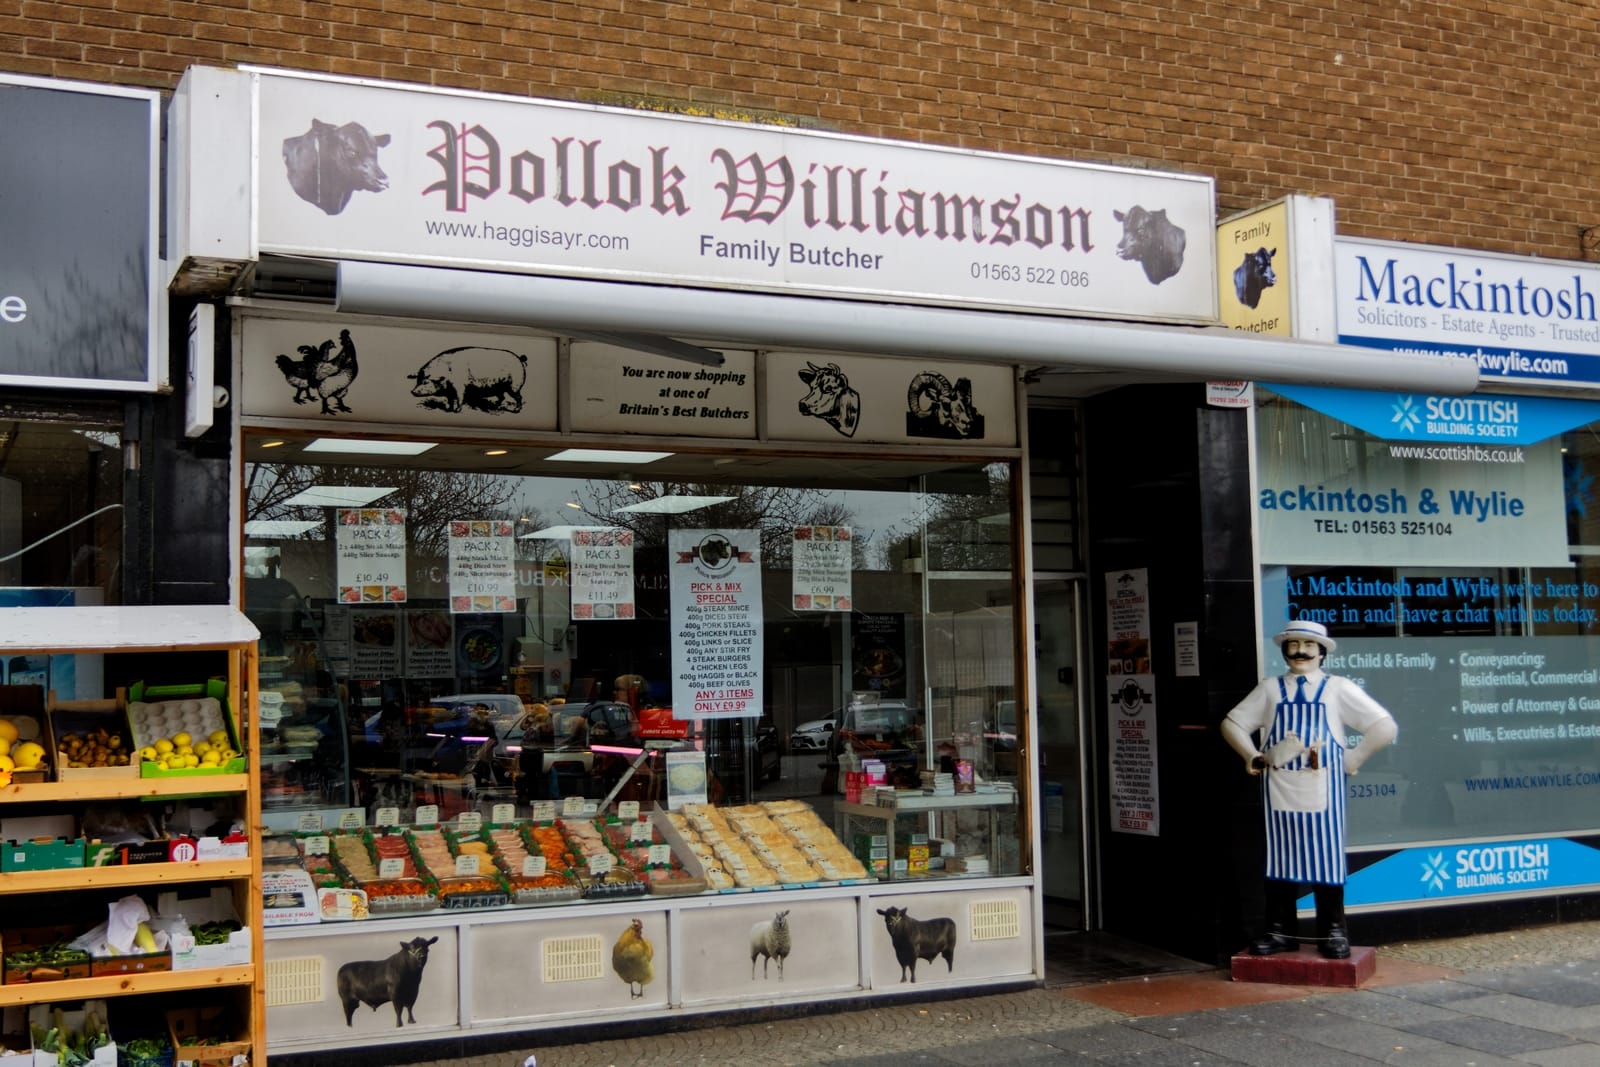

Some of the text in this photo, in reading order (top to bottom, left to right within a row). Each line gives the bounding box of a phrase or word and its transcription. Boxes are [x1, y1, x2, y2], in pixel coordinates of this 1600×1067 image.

[423, 119, 1095, 253] Pollok Williamson
[425, 219, 629, 251] www.haggisayr.com
[1235, 221, 1271, 244] Family
[700, 234, 883, 270] Family Butcher
[970, 261, 1089, 288] 01563 522 086
[1355, 256, 1598, 321] Mackintosh
[1357, 306, 1427, 329] Solicitors
[1441, 313, 1484, 334] Estate
[1488, 318, 1536, 341] Agents
[1548, 322, 1600, 343] Trusted
[1393, 348, 1568, 375] mackwylie.com
[622, 366, 746, 386] You are now shopping
[659, 387, 711, 399] at one of
[619, 403, 750, 419] Britain's Best Butchers
[1426, 396, 1518, 424] SCOTTISH
[1427, 422, 1518, 437] BUILDING SOCIETY
[1390, 446, 1524, 463] www.scottishbs.co.uk
[1418, 488, 1440, 515] &
[1449, 490, 1525, 523] Wylie
[353, 530, 381, 539] PACK
[1314, 519, 1452, 536] TEL: 01563 525104
[464, 542, 500, 551] PACK 2
[586, 550, 620, 559] PACK 3
[807, 543, 831, 552] PACK
[467, 584, 499, 593] £10.99
[691, 583, 742, 591] PICK & MIX
[1308, 576, 1412, 597] Mackintosh
[1416, 577, 1448, 597] and
[1452, 576, 1500, 603] Wylie
[1546, 577, 1579, 598] here
[1584, 581, 1599, 598] to
[588, 592, 618, 600] £11.49
[696, 594, 737, 603] SPECIAL
[686, 606, 702, 614] 400g
[688, 614, 703, 622] 400g
[1284, 602, 1599, 628] Come in and have a chat with us today.
[679, 631, 696, 639] 400g
[686, 648, 703, 656] 400g
[1460, 652, 1545, 669] Conveyancing:
[1348, 654, 1381, 668] Child
[1384, 654, 1393, 668] &
[1395, 652, 1436, 671] Family
[1461, 670, 1598, 687] Residential, Commercial
[696, 689, 754, 699] ANY 3 ITEMS
[695, 701, 746, 711] ONLY £9.99
[1462, 700, 1499, 714] Power
[1501, 698, 1515, 713] of
[1516, 698, 1567, 715] Attorney
[1568, 697, 1577, 711] &
[1464, 727, 1495, 743] Wills,
[1497, 726, 1555, 741] Executries
[1557, 725, 1568, 738] &
[1465, 774, 1600, 791] WWW.MACKWYLIE.COM
[1350, 784, 1396, 799] 525104
[1456, 844, 1549, 874] SCOTTISH
[1456, 868, 1549, 889] BUILDING SOCIETY
